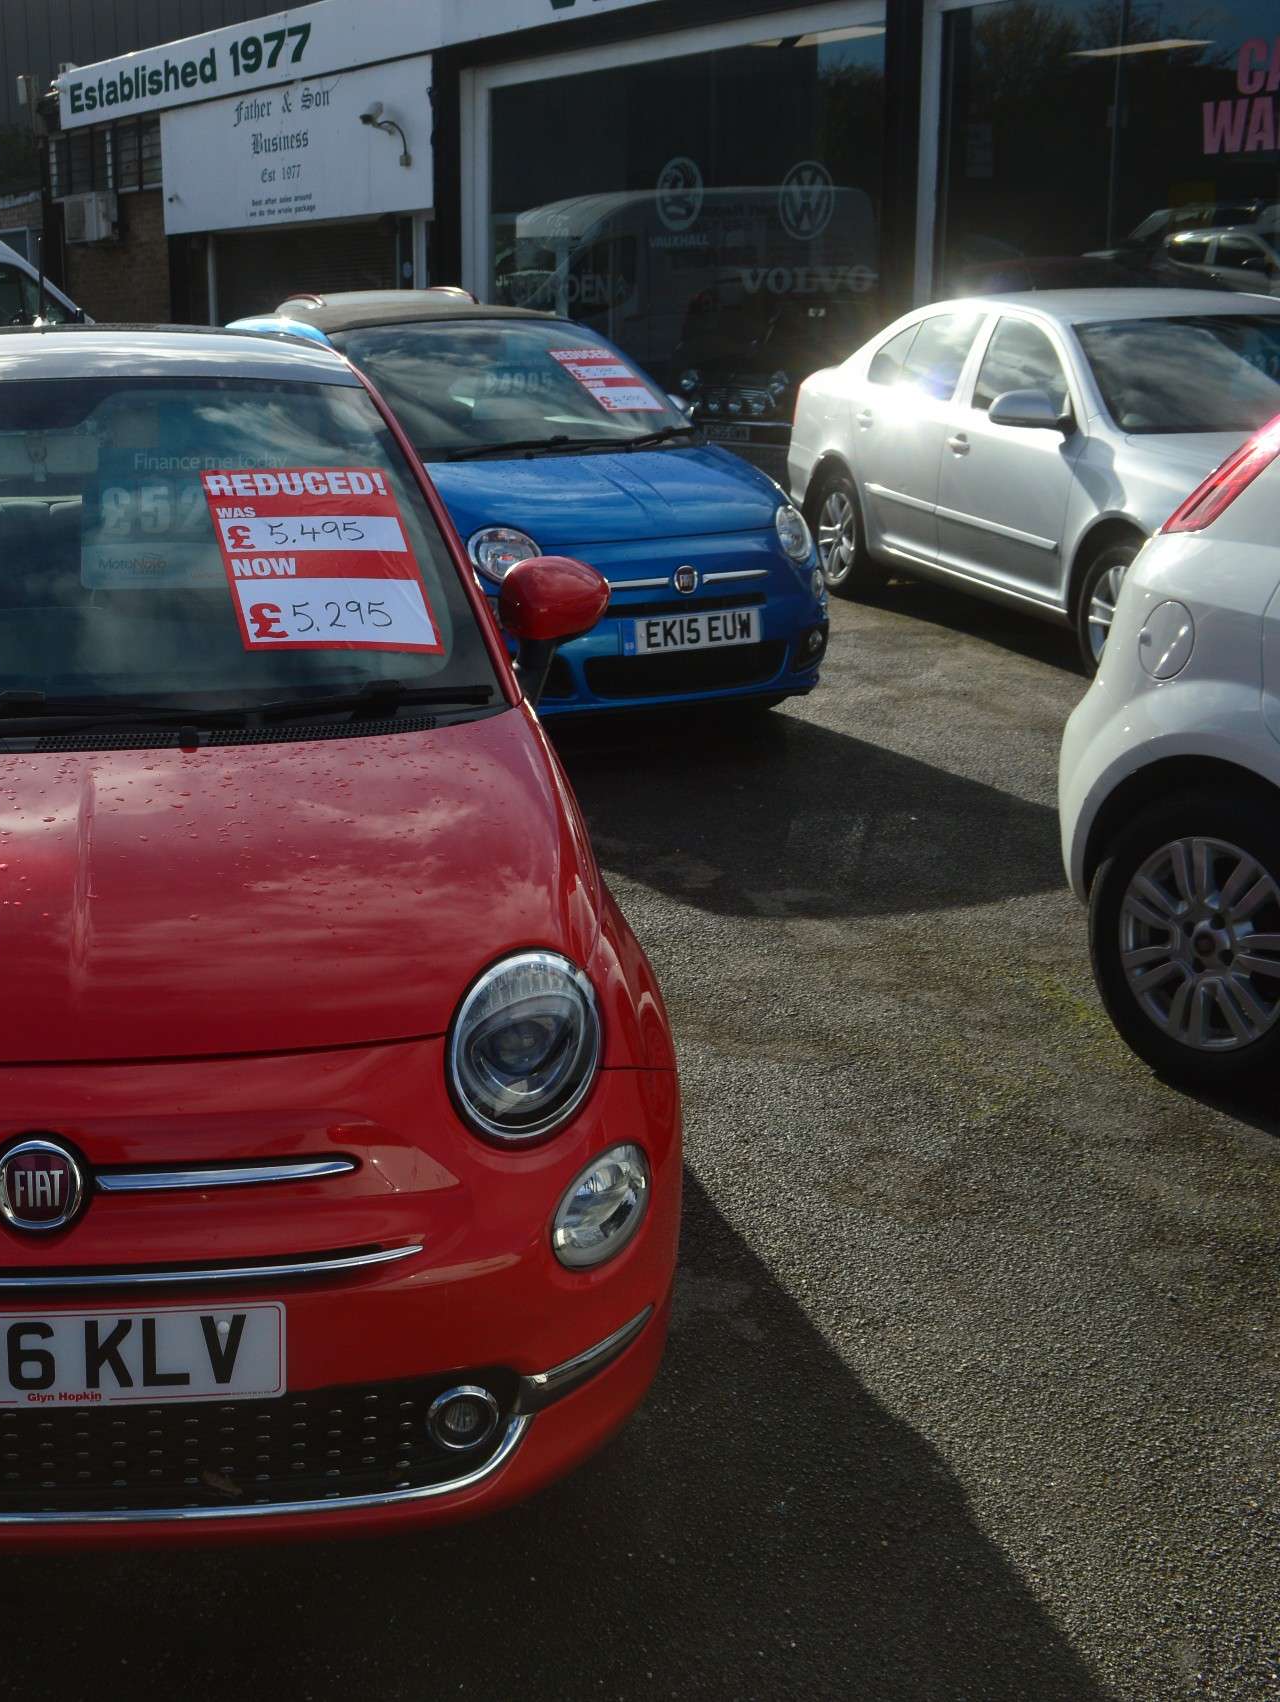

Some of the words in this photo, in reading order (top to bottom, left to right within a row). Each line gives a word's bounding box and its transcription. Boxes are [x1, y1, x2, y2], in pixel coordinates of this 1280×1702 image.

[70, 47, 218, 114] Established
[229, 23, 312, 77] 1977
[233, 98, 272, 127] Father
[282, 91, 292, 113] &
[301, 88, 330, 111] Son
[1202, 95, 1280, 155] WA
[251, 130, 309, 154] Business
[260, 168, 276, 183] Est
[282, 164, 302, 180] 1977
[737, 265, 877, 294] VOLVO
[133, 452, 201, 471] Finance
[206, 456, 233, 470] me
[237, 453, 288, 472] today
[205, 472, 388, 497] REDUCED!
[216, 506, 257, 520] WAS
[267, 520, 365, 546] 5.495
[231, 557, 297, 577] NOW
[291, 600, 394, 633] 5.295
[707, 612, 752, 643] EUW
[14, 1170, 64, 1208] FIAT
[84, 1313, 248, 1389] KLV
[27, 1392, 55, 1403] Glyn
[58, 1391, 102, 1403] Hopkin
